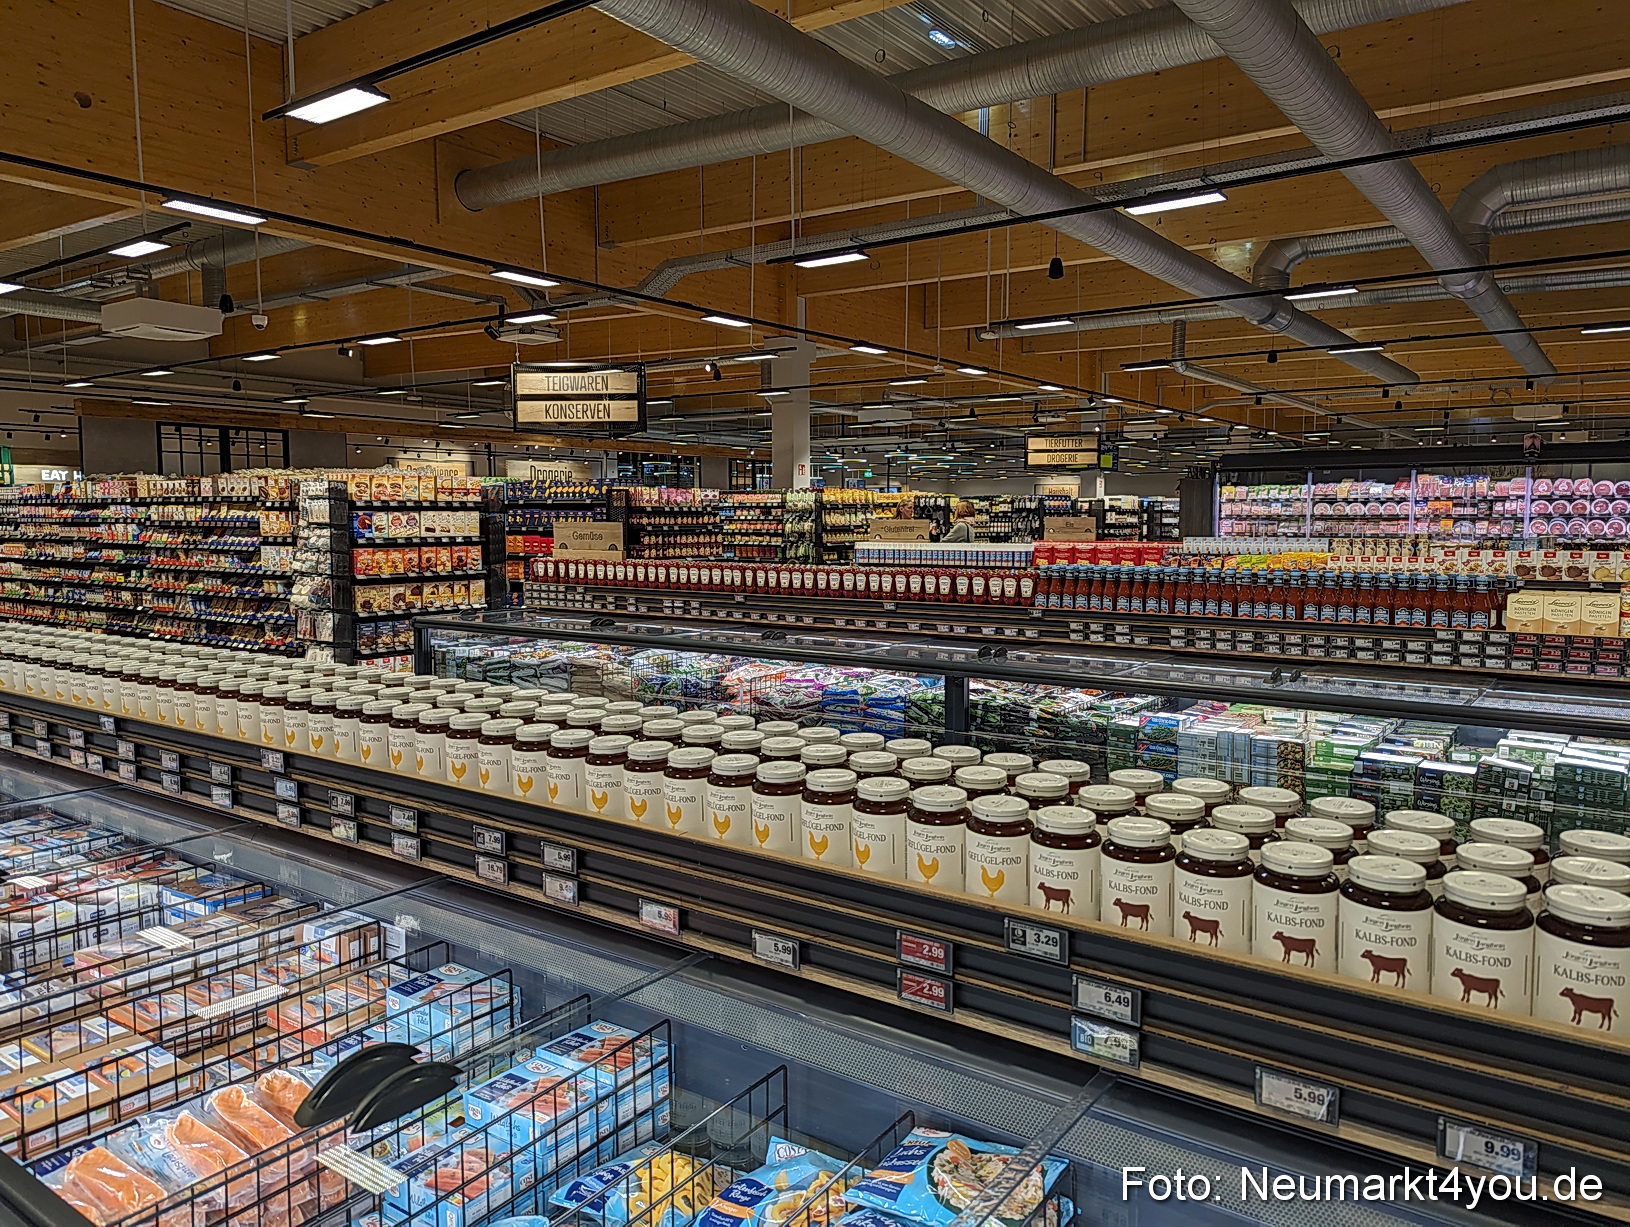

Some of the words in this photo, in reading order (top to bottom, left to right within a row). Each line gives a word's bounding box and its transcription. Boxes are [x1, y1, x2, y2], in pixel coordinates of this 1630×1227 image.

[545, 375, 609, 391] TEIGWAREN
[544, 403, 610, 420] KONSERVEN
[1044, 439, 1083, 448] TIERFUTTER
[1047, 454, 1078, 463] DROGERIE
[42, 470, 68, 480] EAT
[530, 466, 572, 482] Drogerie
[572, 530, 603, 540] Gemüse
[968, 850, 1022, 866] GEFLÜGEL-FOND
[1034, 864, 1079, 880] KALBS-FOND
[1108, 880, 1158, 895] KALBS-FOND
[1178, 892, 1228, 910] KALBS-FOND
[1267, 911, 1324, 928] KALBS-FOND
[1034, 933, 1058, 947] 3.29
[1355, 928, 1417, 947] KALBS-FOND
[774, 943, 792, 955] 5.99
[922, 944, 944, 958] 2.99
[1446, 945, 1512, 968] KALBS-FOND
[1554, 964, 1626, 986] KALBS-FOND
[923, 984, 944, 997] 2.99
[1104, 992, 1129, 1007] 6.49
[1081, 1035, 1092, 1044] BIO
[1294, 1088, 1325, 1106] 5.99
[1484, 1140, 1521, 1161] 9.99
